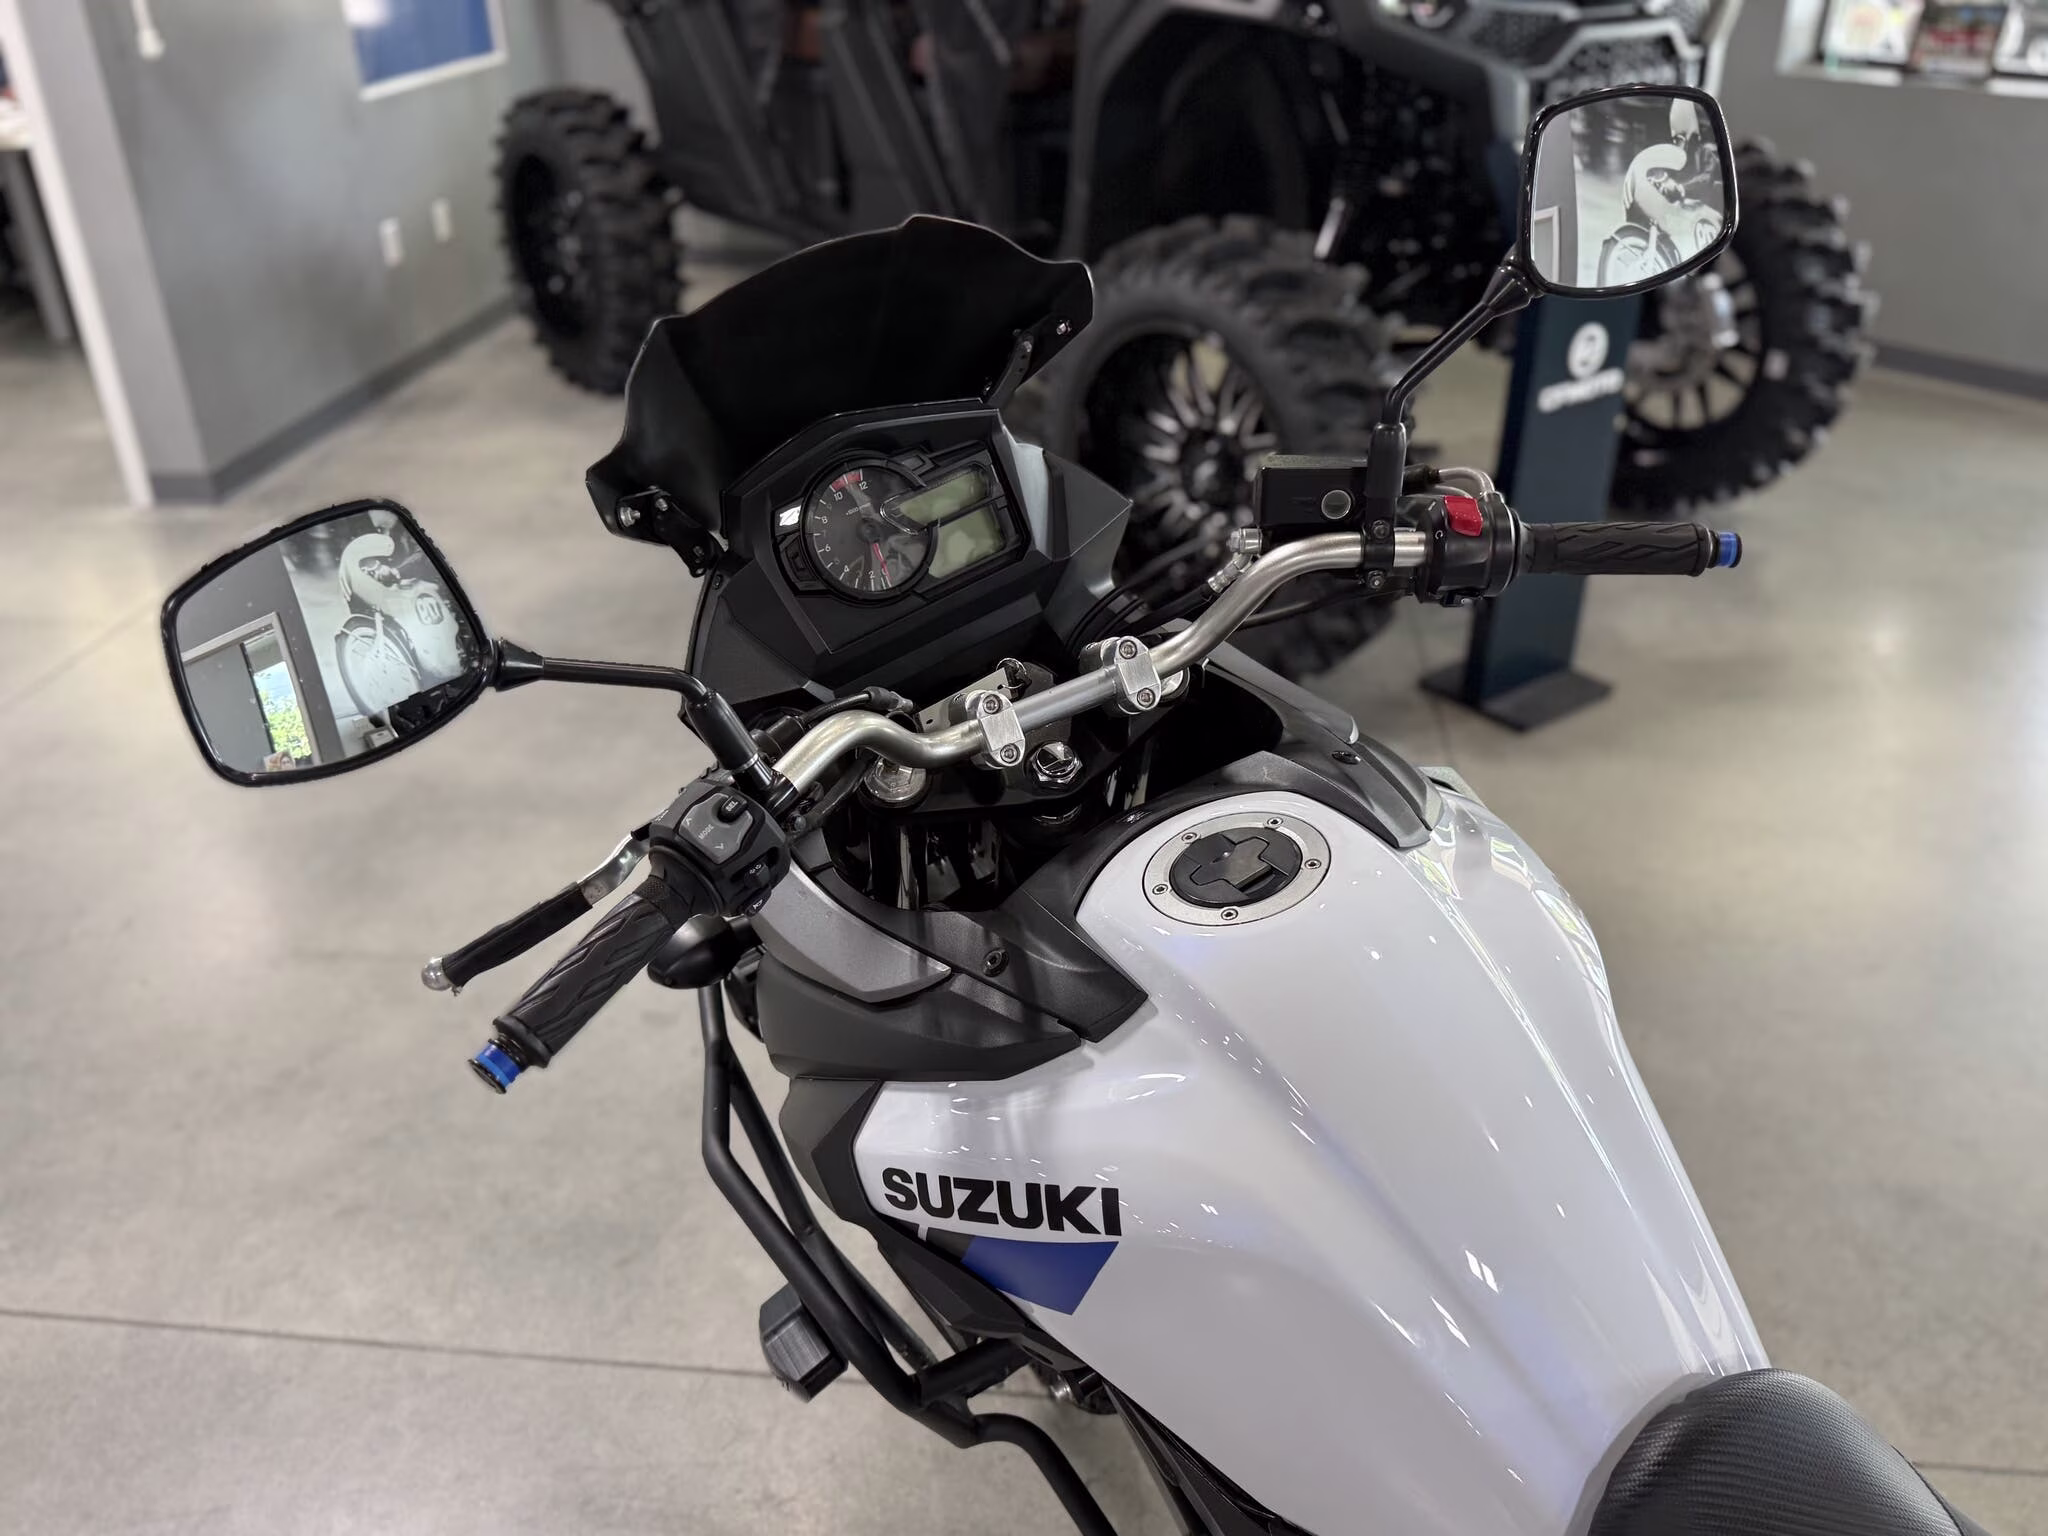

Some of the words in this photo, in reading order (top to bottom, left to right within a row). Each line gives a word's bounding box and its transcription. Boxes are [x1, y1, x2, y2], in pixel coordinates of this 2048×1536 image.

[859, 481, 868, 490] 12
[834, 492, 843, 501] 10
[821, 515, 828, 524] 8
[825, 544, 831, 552] 6
[843, 565, 850, 573] 4
[869, 570, 875, 579] 2
[698, 824, 715, 840] MODE
[882, 1167, 1122, 1236] SUZUKI
